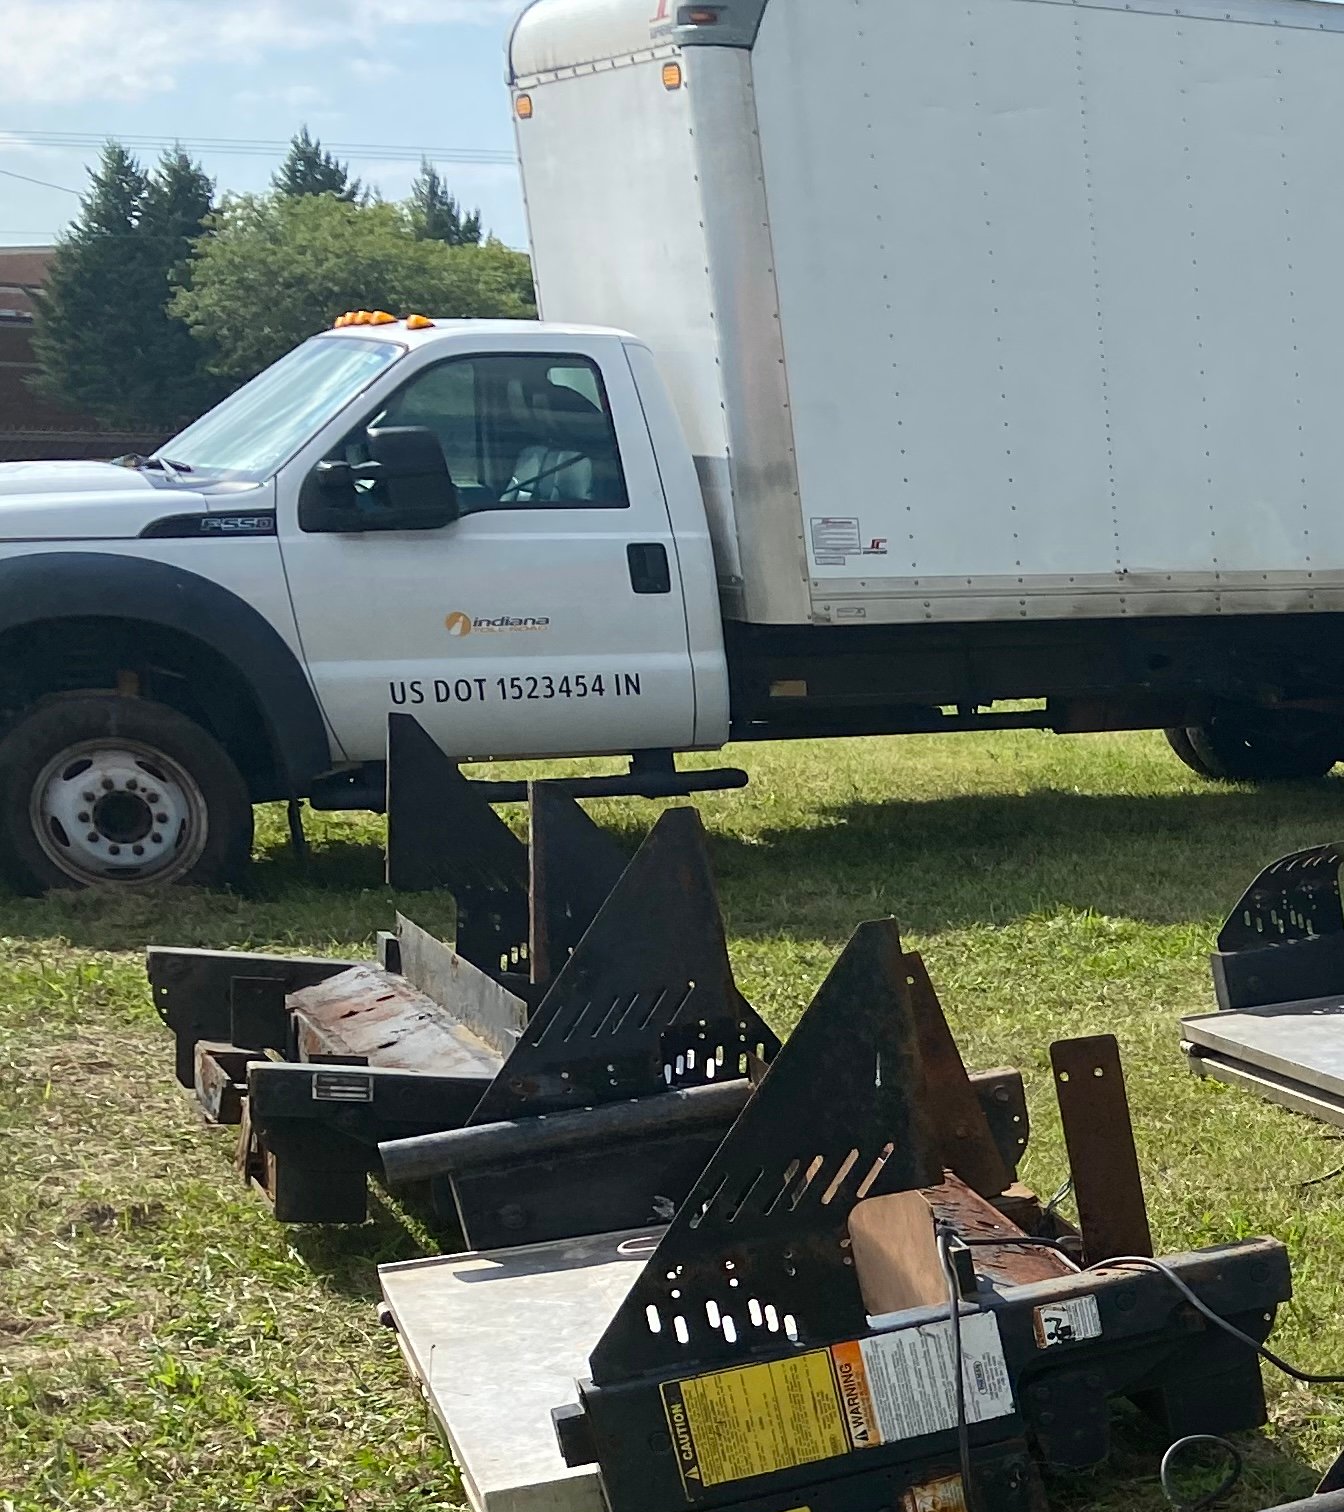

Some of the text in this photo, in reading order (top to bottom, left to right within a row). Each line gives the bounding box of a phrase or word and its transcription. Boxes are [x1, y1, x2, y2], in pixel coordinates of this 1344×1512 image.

[473, 616, 550, 627] indiana
[389, 673, 642, 705] US DOT 1523454 IN
[839, 1363, 865, 1430] WARNING
[671, 1404, 693, 1460] CAUTION
